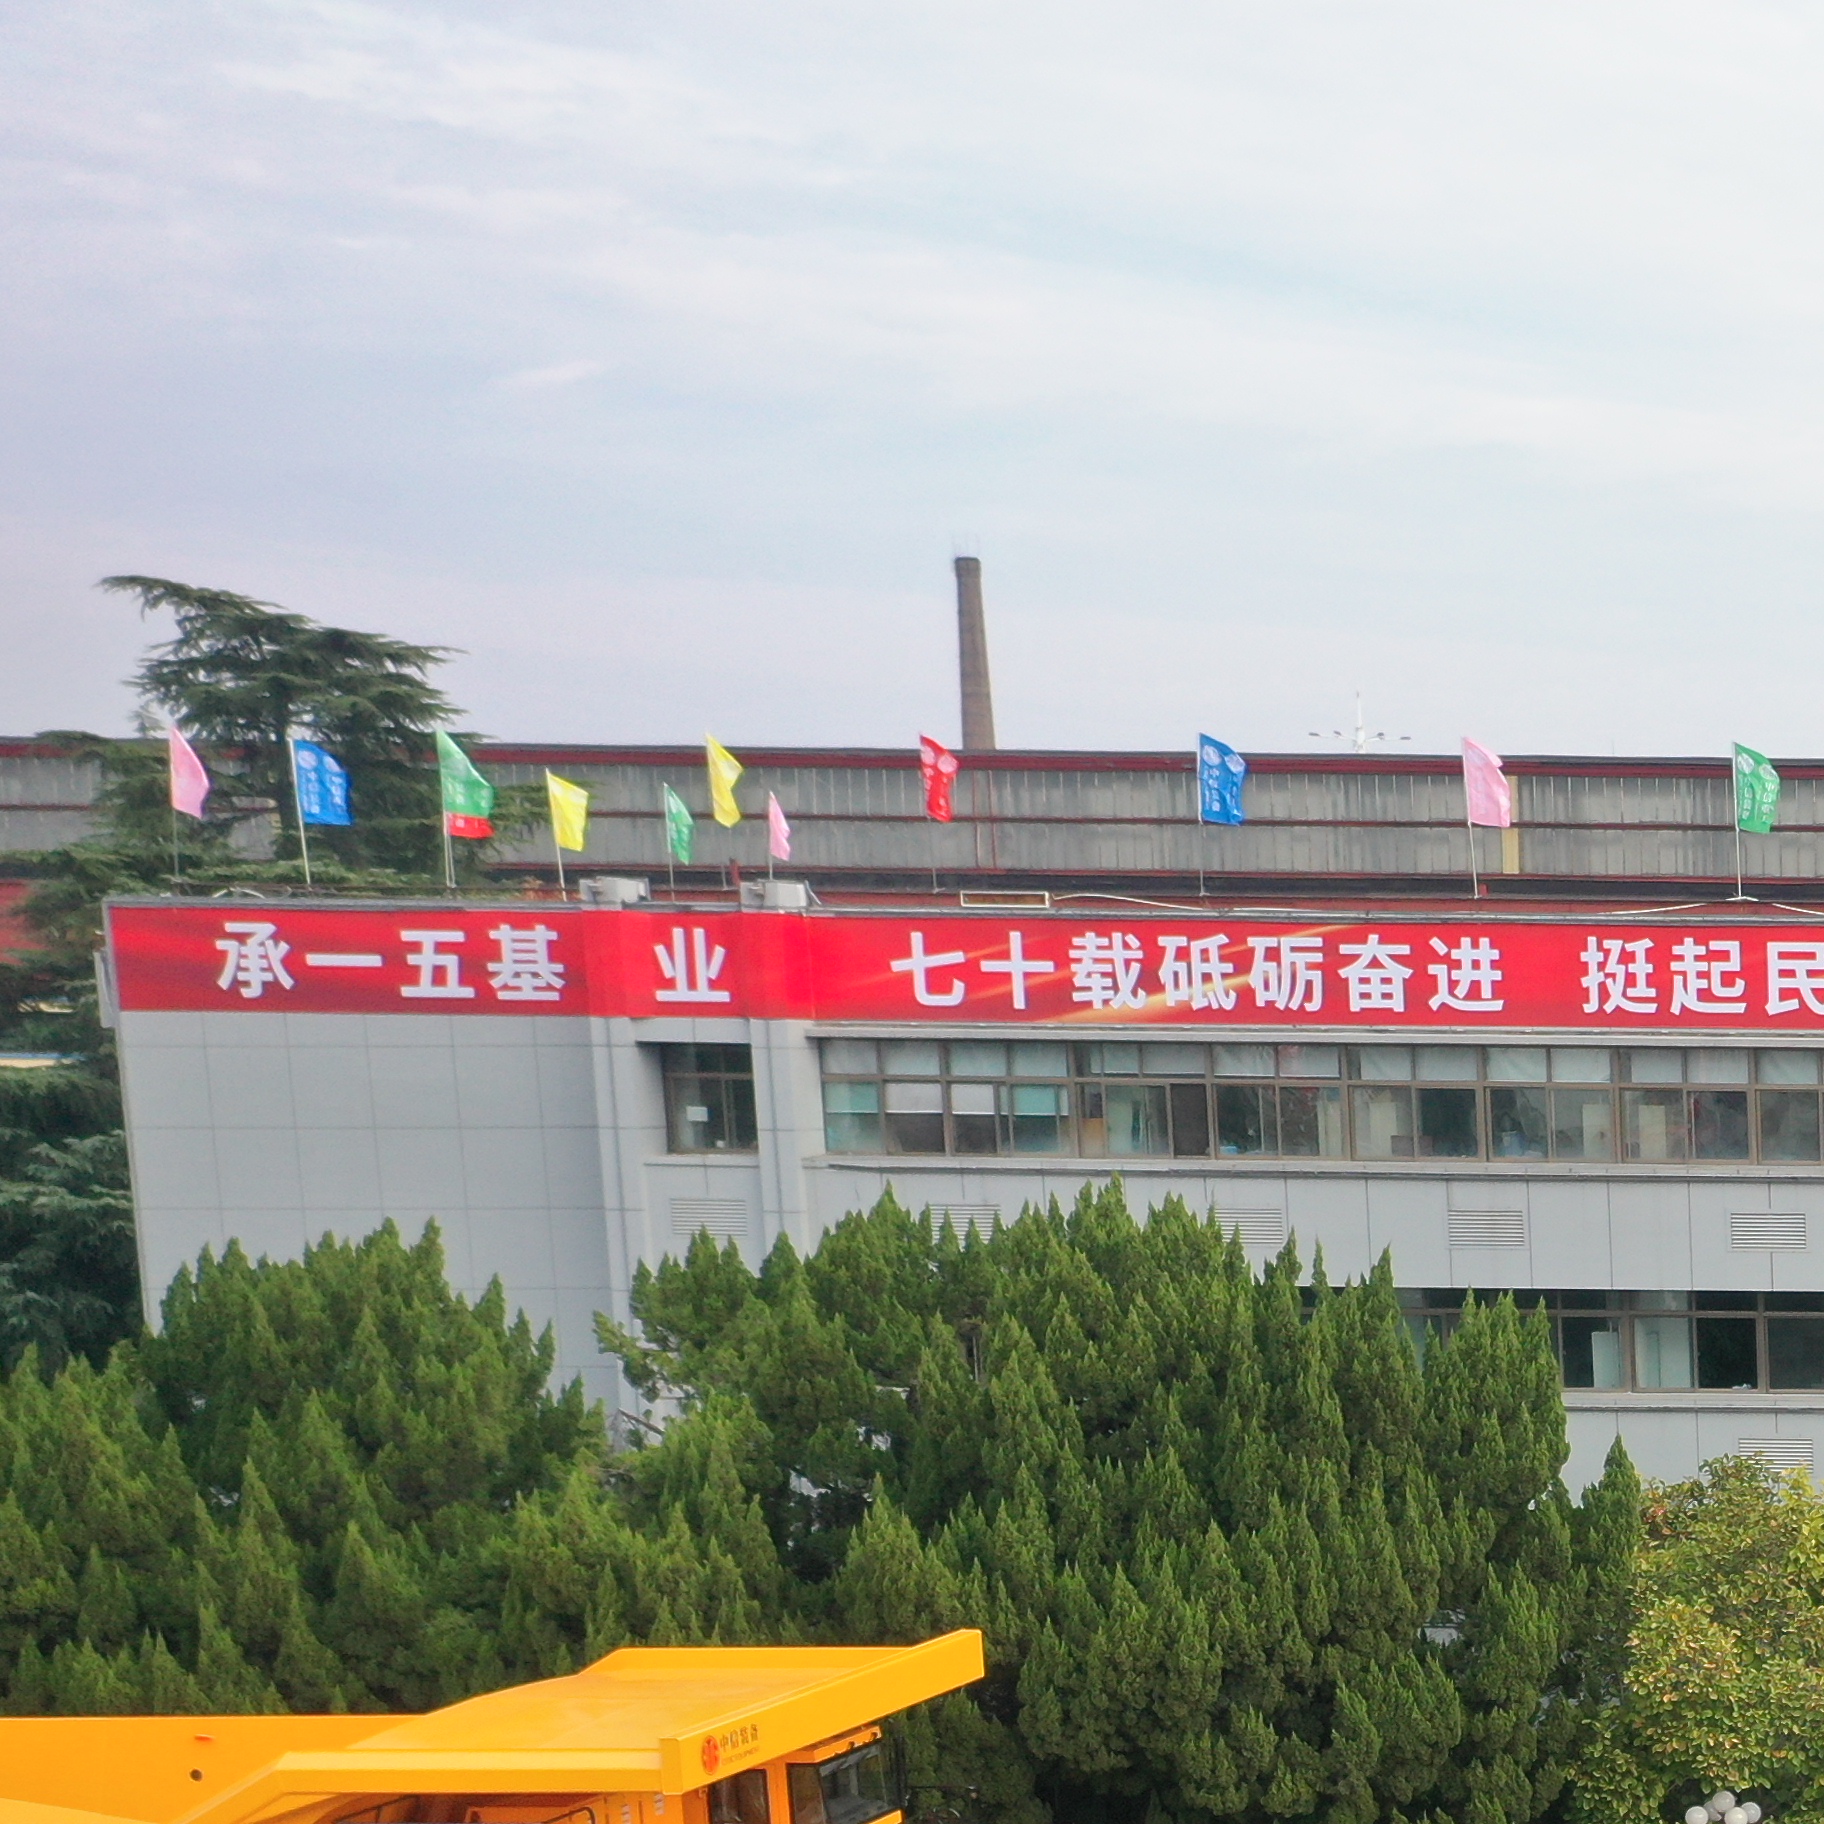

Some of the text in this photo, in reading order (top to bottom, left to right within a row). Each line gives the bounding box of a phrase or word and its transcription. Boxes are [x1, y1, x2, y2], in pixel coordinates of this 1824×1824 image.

[890, 930, 1506, 1012] 七十载砥砺奋进
